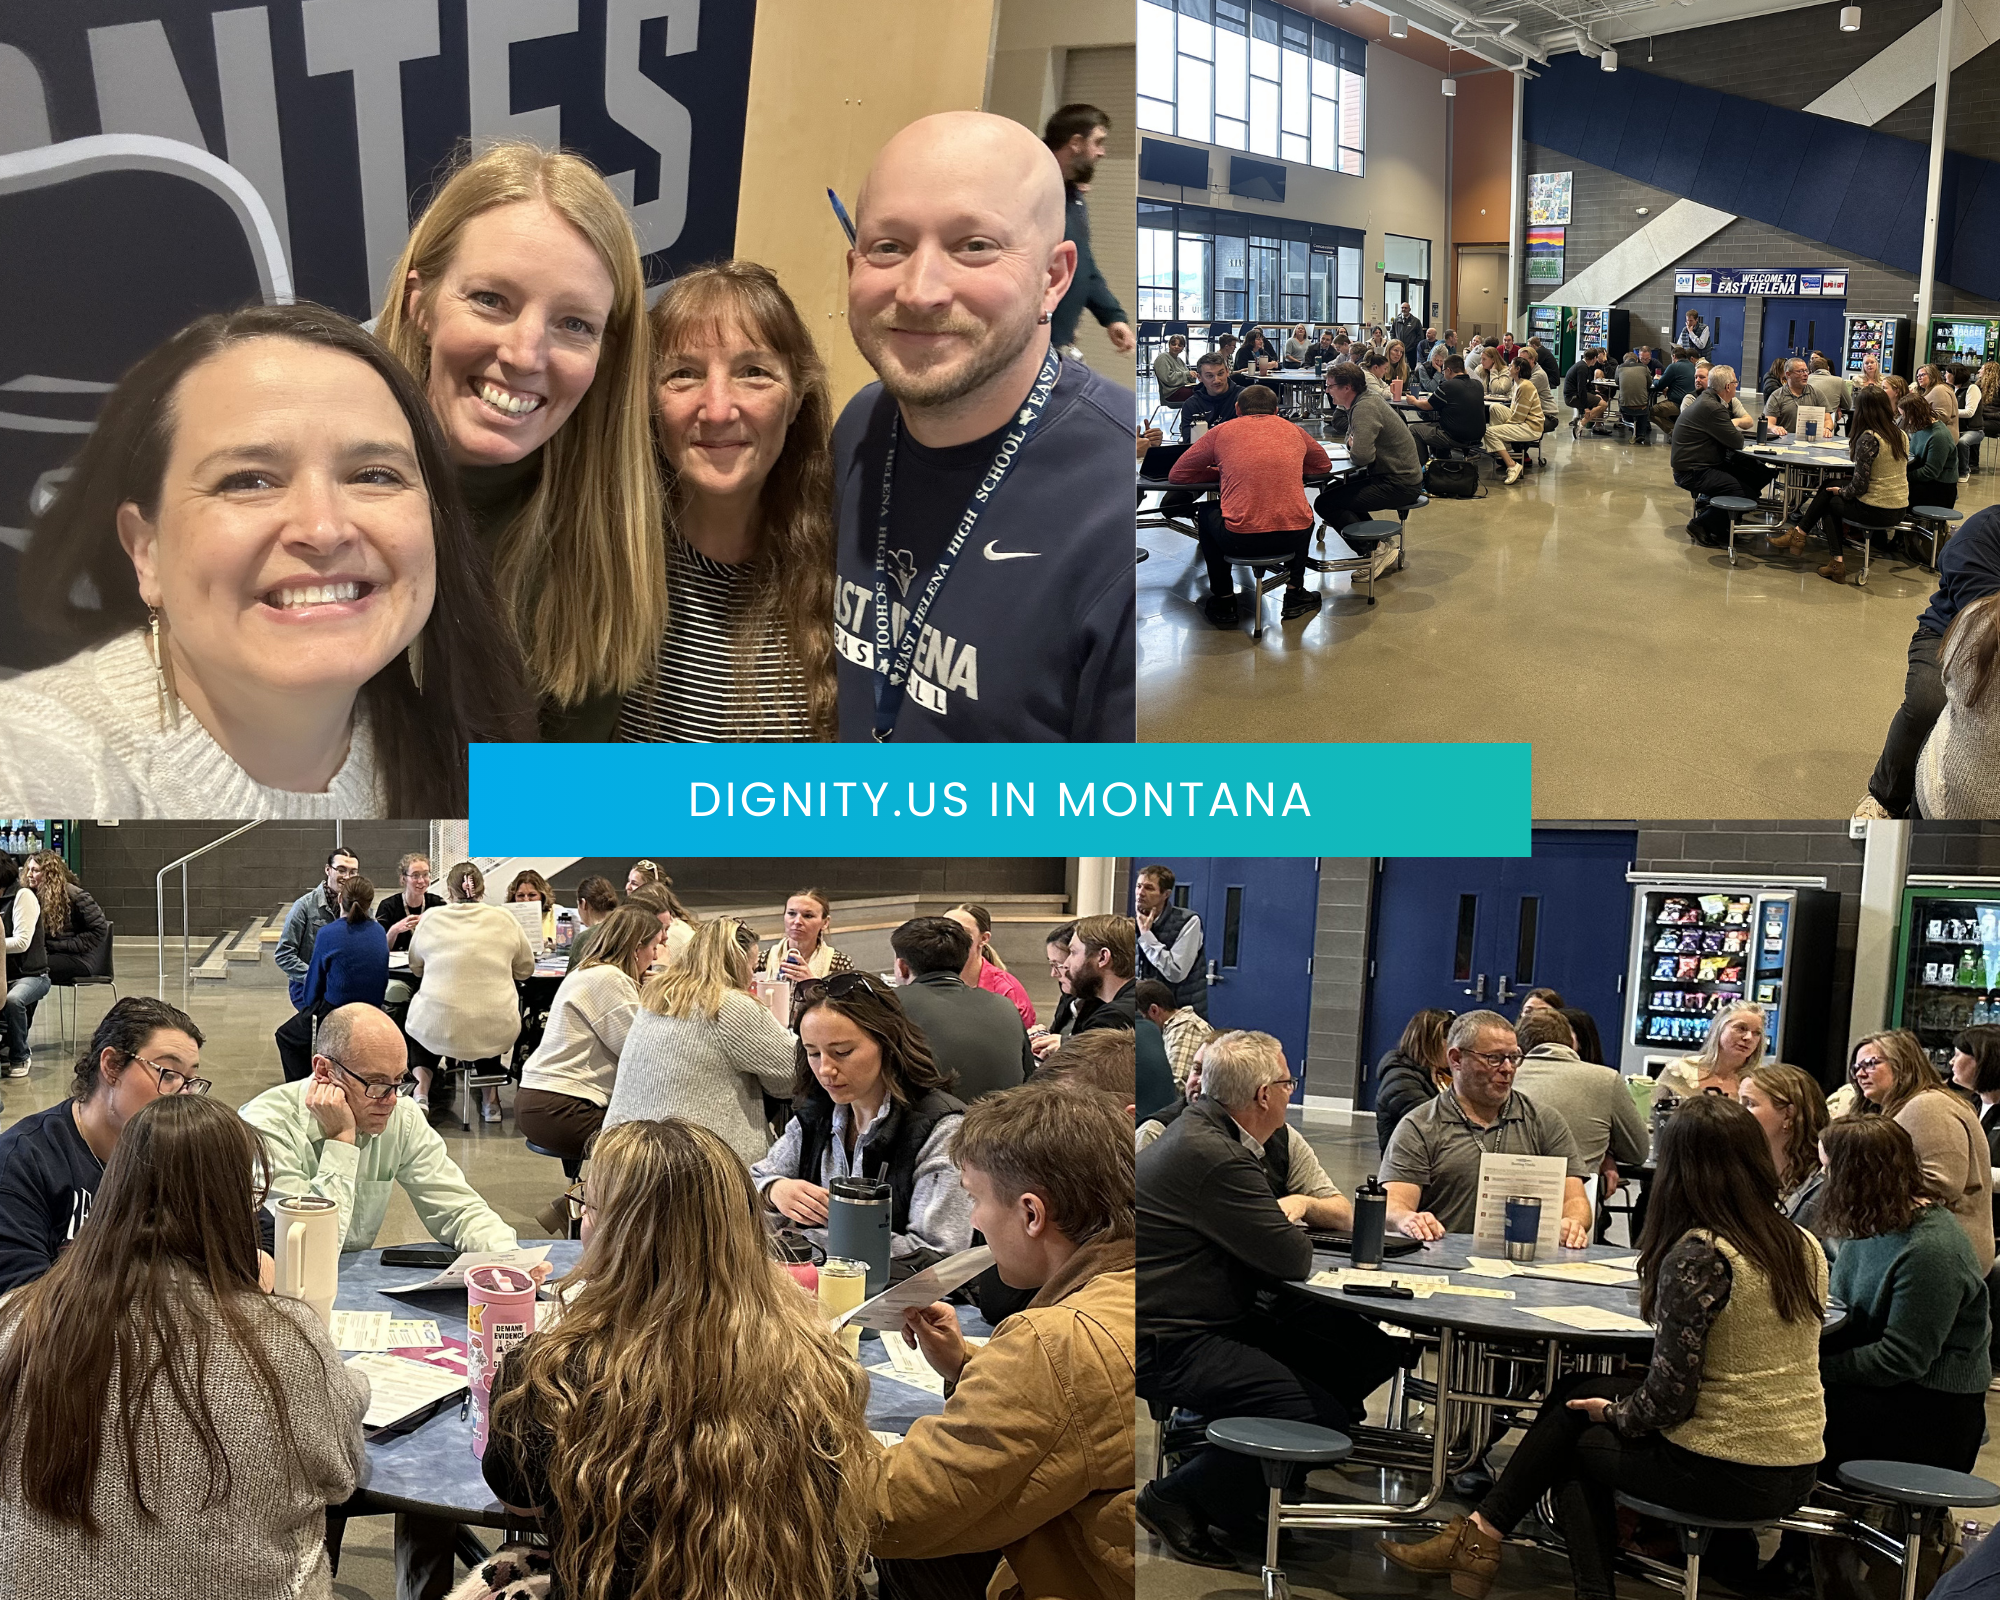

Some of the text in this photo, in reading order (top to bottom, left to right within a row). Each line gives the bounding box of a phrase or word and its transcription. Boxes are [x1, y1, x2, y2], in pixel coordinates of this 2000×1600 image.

[1717, 282, 1795, 295] EAST HELENA
[1742, 274, 1783, 283] WELCOME
[1785, 274, 1797, 282] TO
[1153, 305, 1184, 313] HELEA
[1027, 362, 1056, 408] EAST
[880, 449, 896, 518] HELENA
[876, 526, 888, 572] HIGH
[894, 430, 1027, 674] EAST HELENA HIGH SCHOOL
[876, 582, 891, 655] SCHOOL
[496, 1324, 524, 1332] DEMAND
